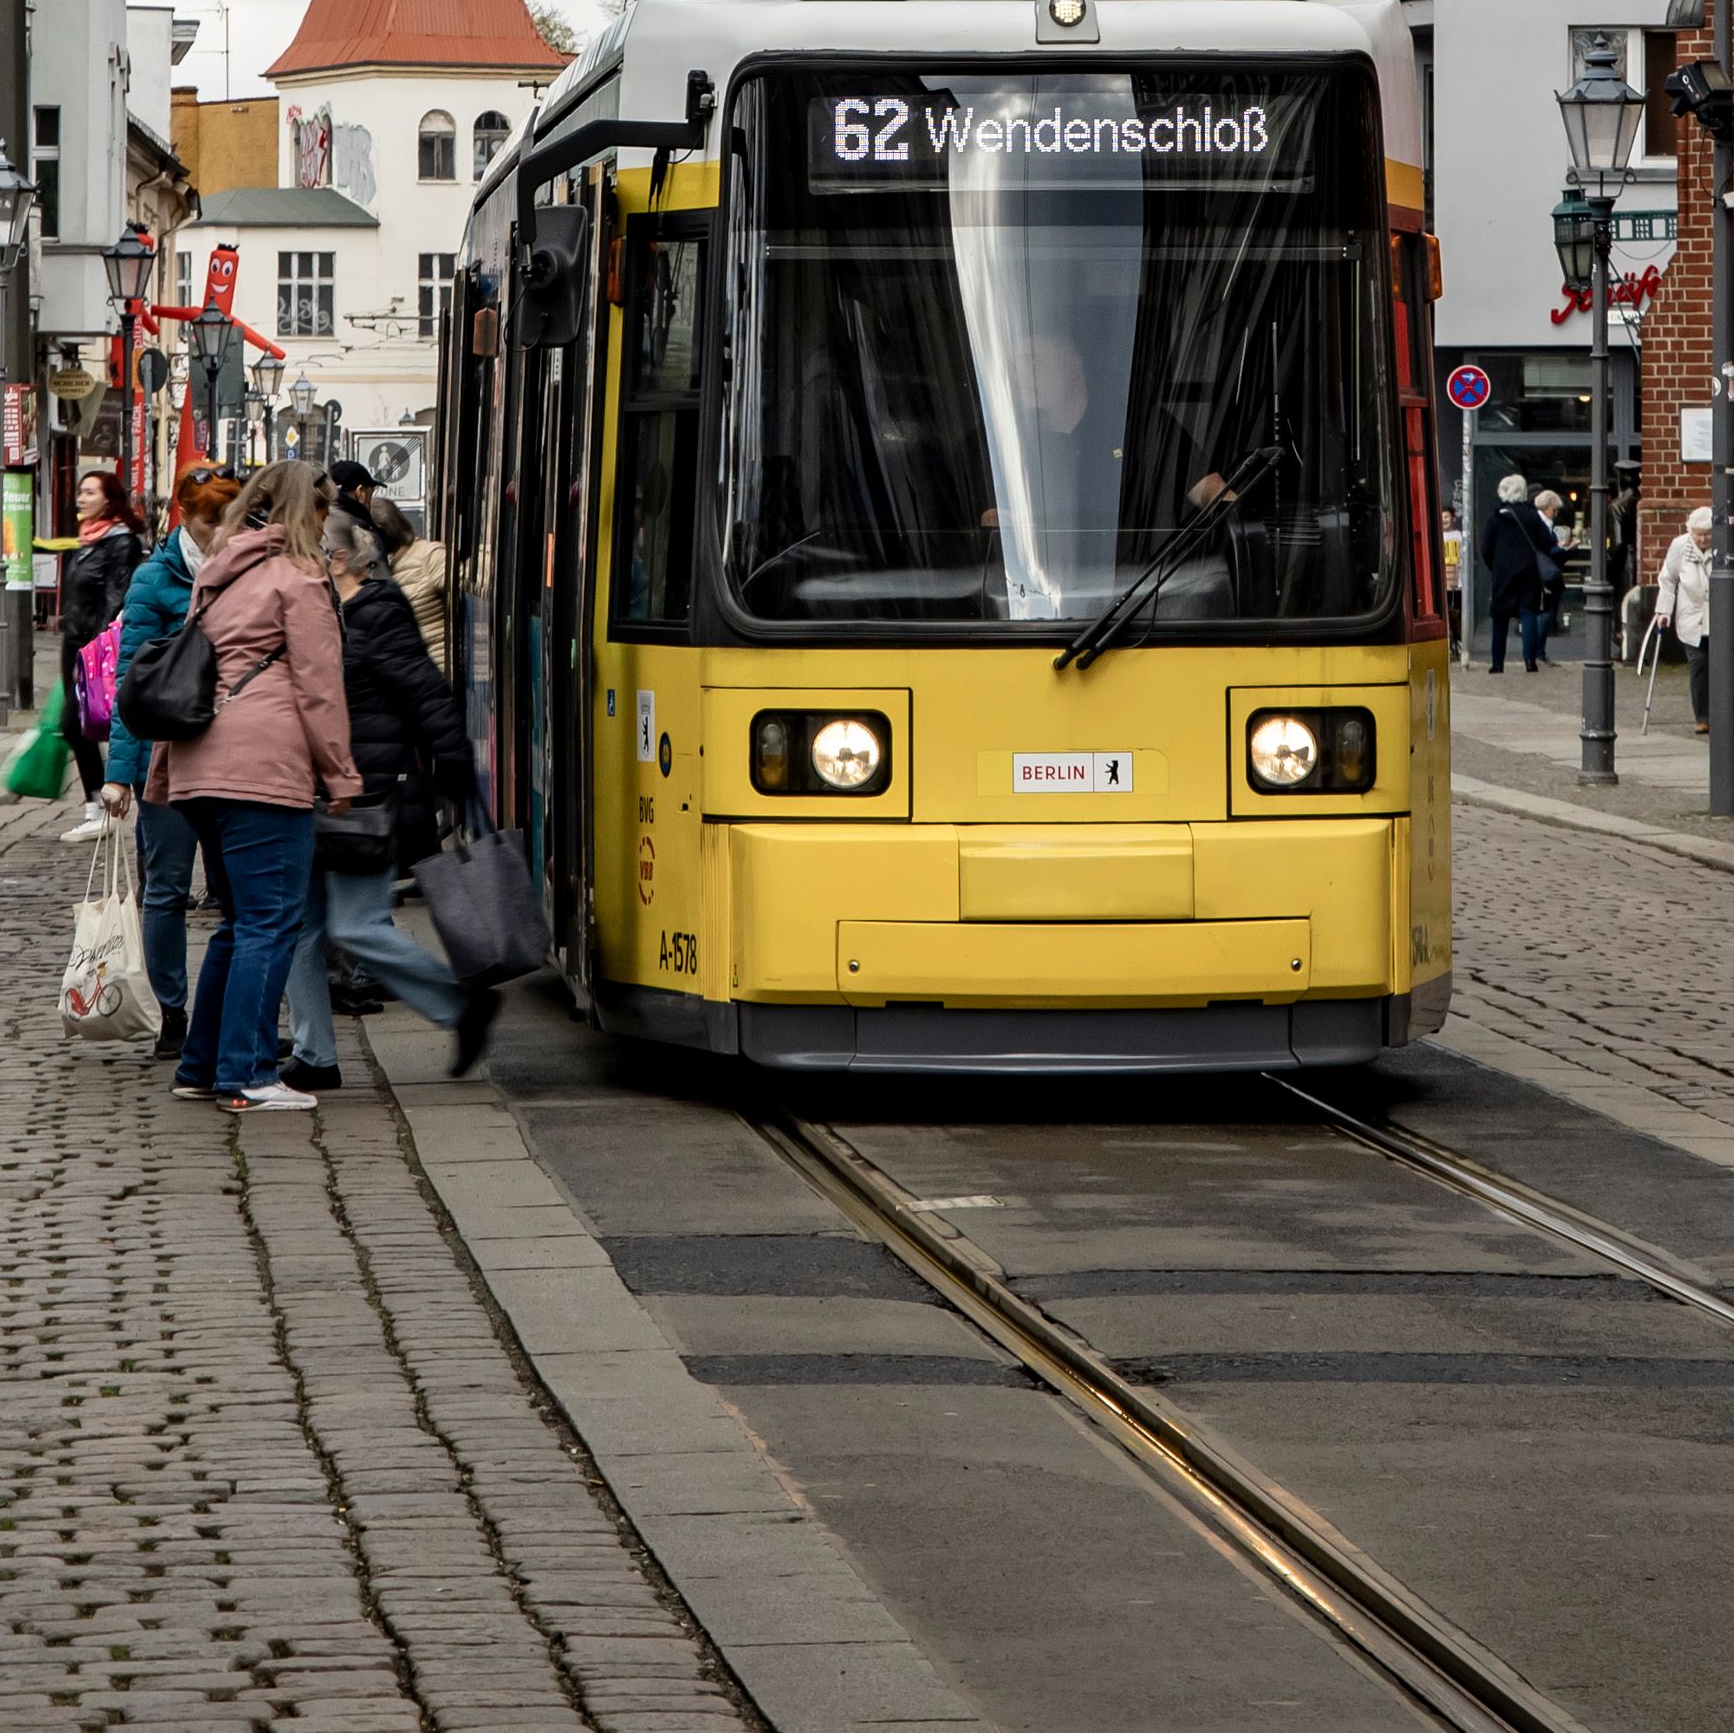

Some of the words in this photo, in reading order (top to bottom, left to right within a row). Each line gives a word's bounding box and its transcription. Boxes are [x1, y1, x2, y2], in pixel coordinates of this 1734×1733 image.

[834, 98, 909, 161] 62
[924, 105, 1269, 153] Wendenschloß
[1022, 765, 1085, 780] BERLIN
[638, 796, 655, 824] BVG
[639, 861, 654, 882] VBB
[659, 929, 698, 976] A-1578
